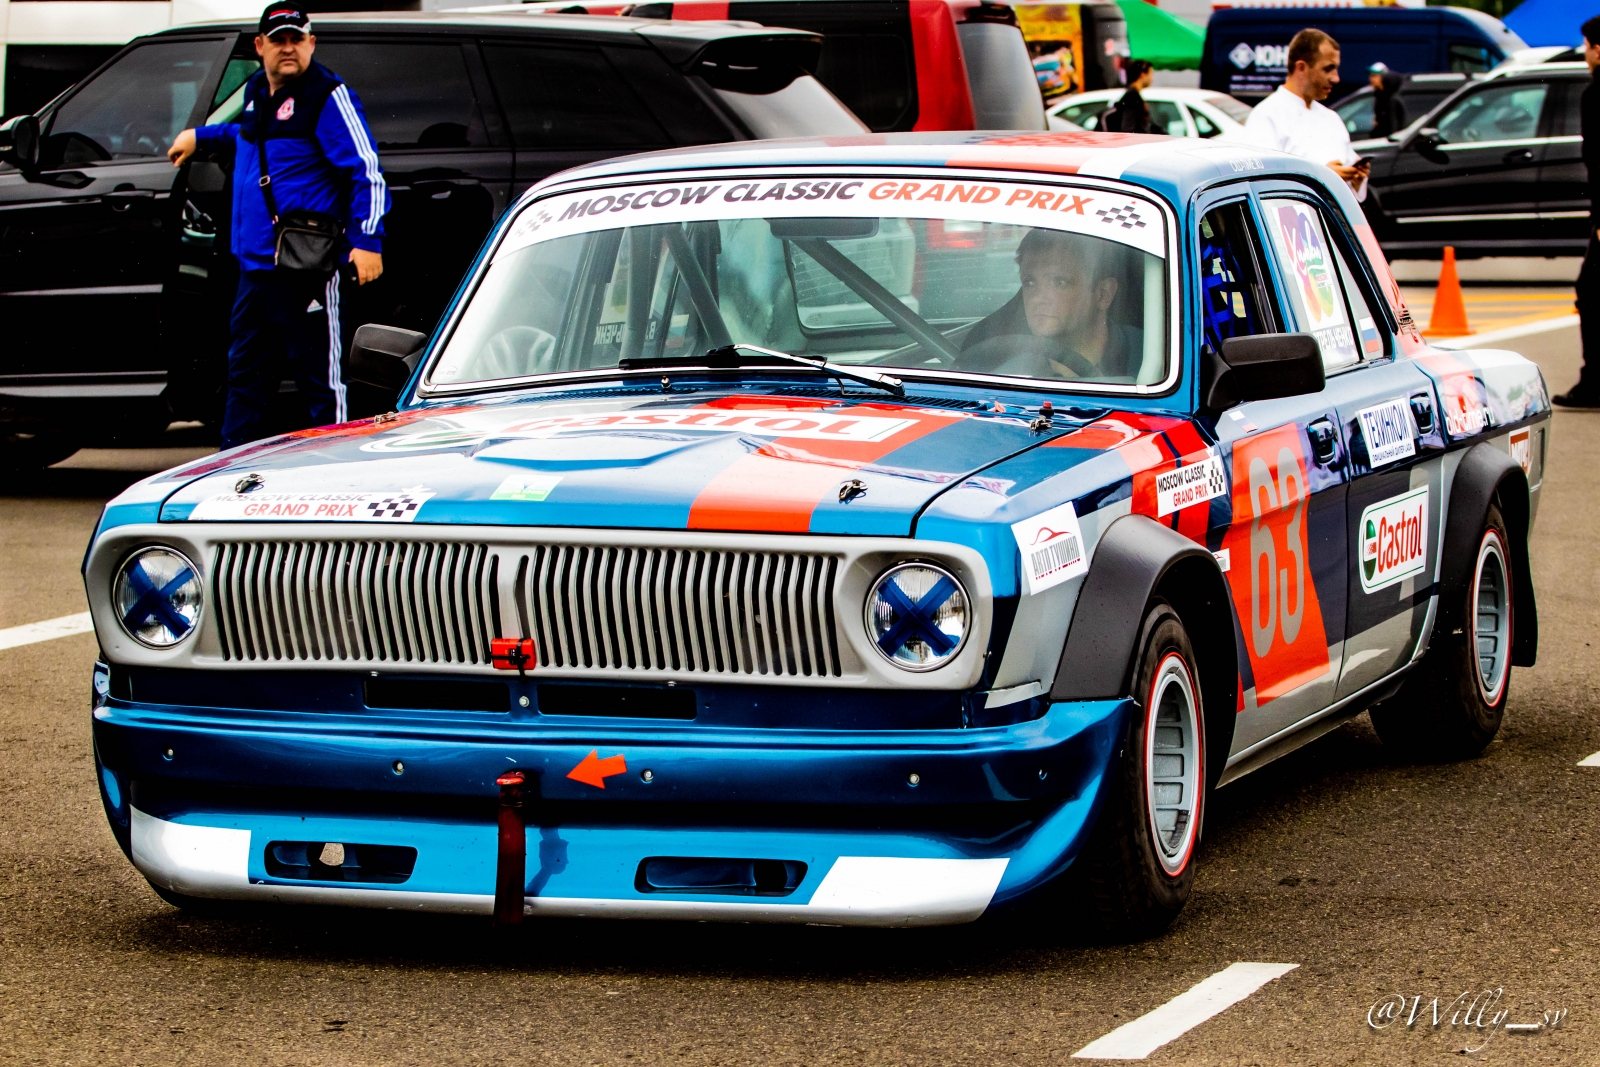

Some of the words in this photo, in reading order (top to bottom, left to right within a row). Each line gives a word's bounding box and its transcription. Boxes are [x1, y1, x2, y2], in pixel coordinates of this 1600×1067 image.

[557, 184, 723, 222] MOSCOW
[723, 181, 864, 203] CLASSIC
[868, 181, 1001, 204] GRAND
[1005, 188, 1095, 216] PRIX
[1312, 325, 1354, 352] ТРЕЛЬЧЕНКО
[501, 412, 862, 435] Castrol
[1363, 403, 1411, 449] ТЕХИНКОМ
[1445, 405, 1496, 436] old-time.ru
[1157, 471, 1184, 494] MOSCOW
[1184, 464, 1206, 484] CLASSIC
[210, 493, 292, 502] MOSCOW
[297, 493, 373, 502] CLASSIC
[243, 503, 311, 517] GRAND
[314, 504, 359, 517] PRIX
[1173, 487, 1194, 507] GRAND
[1194, 483, 1209, 500] PRIX
[1249, 446, 1306, 658] 63
[1378, 503, 1423, 574] Castrol
